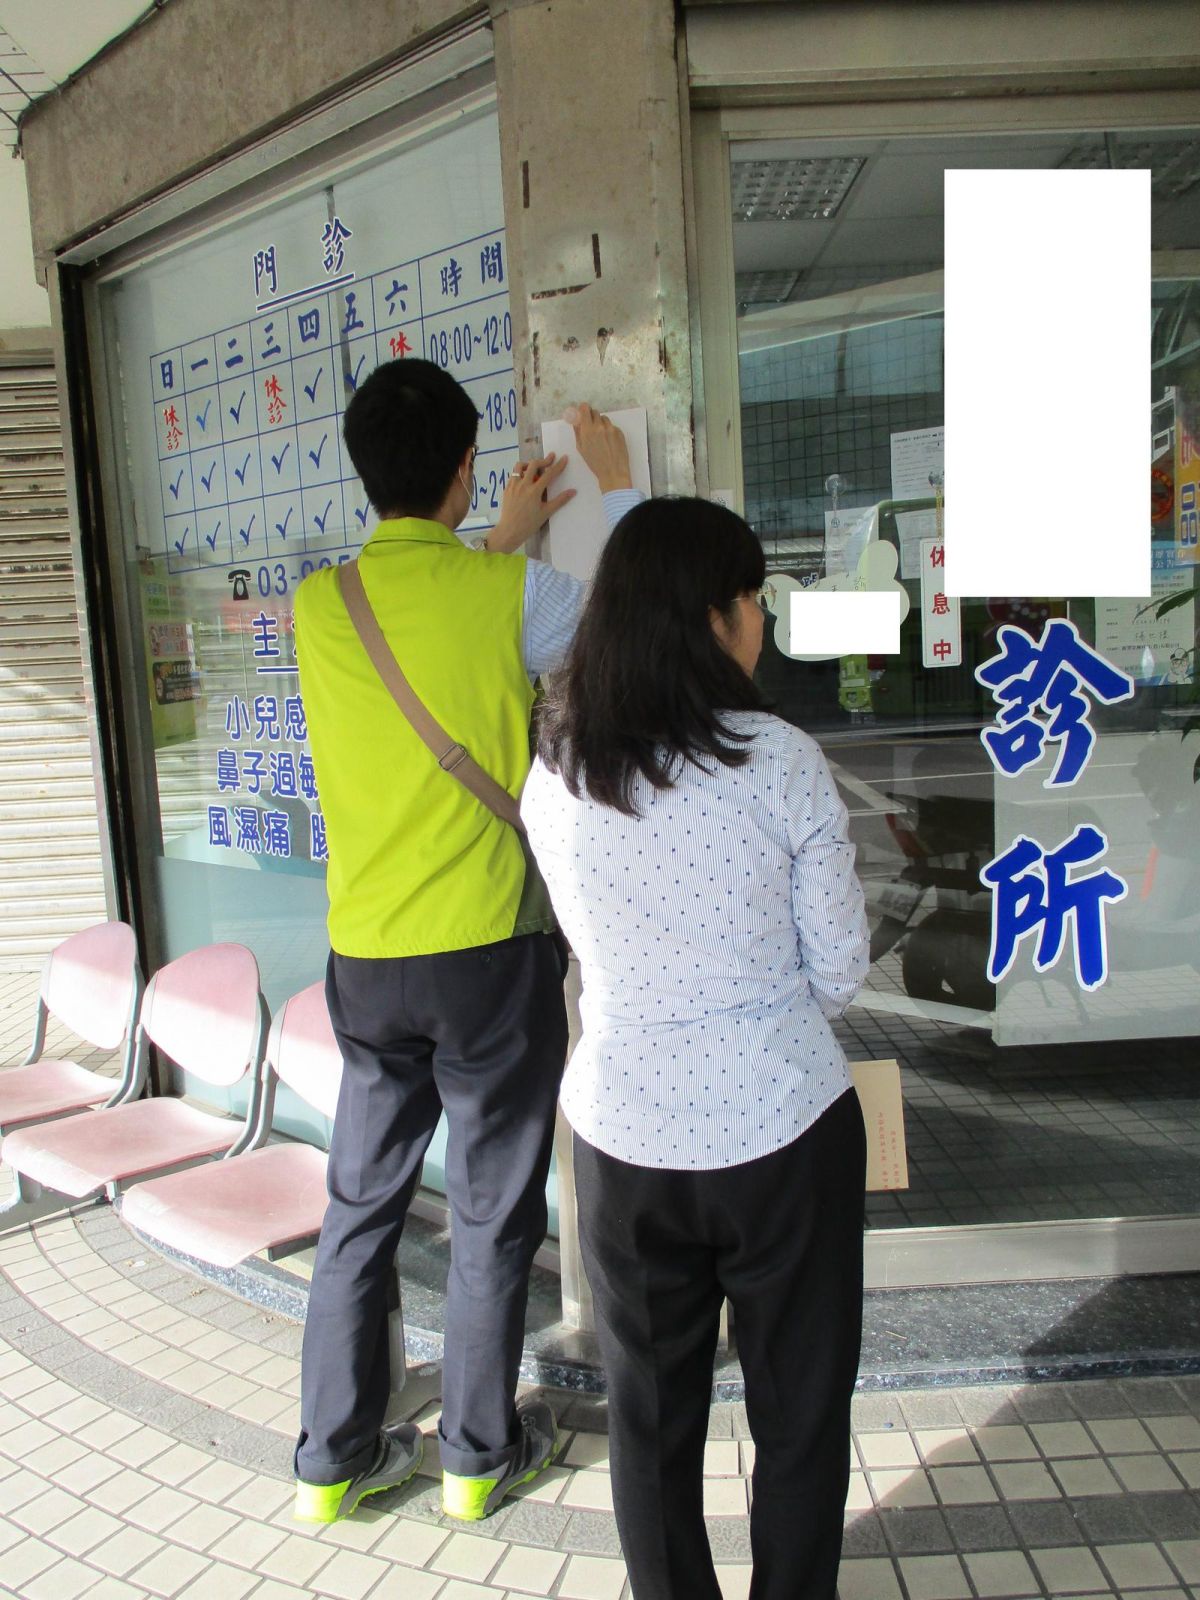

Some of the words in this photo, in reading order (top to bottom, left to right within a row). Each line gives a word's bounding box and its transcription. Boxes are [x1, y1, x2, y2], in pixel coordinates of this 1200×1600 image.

[161, 359, 173, 389] 日
[225, 338, 243, 368] 二
[261, 322, 281, 359] 三
[298, 308, 319, 343] 四
[341, 292, 364, 334] 五
[384, 279, 408, 316] 六
[264, 374, 287, 424] 休診
[163, 405, 183, 451] 休診
[208, 804, 291, 857] 風濕痛
[976, 618, 1134, 993] 診所
